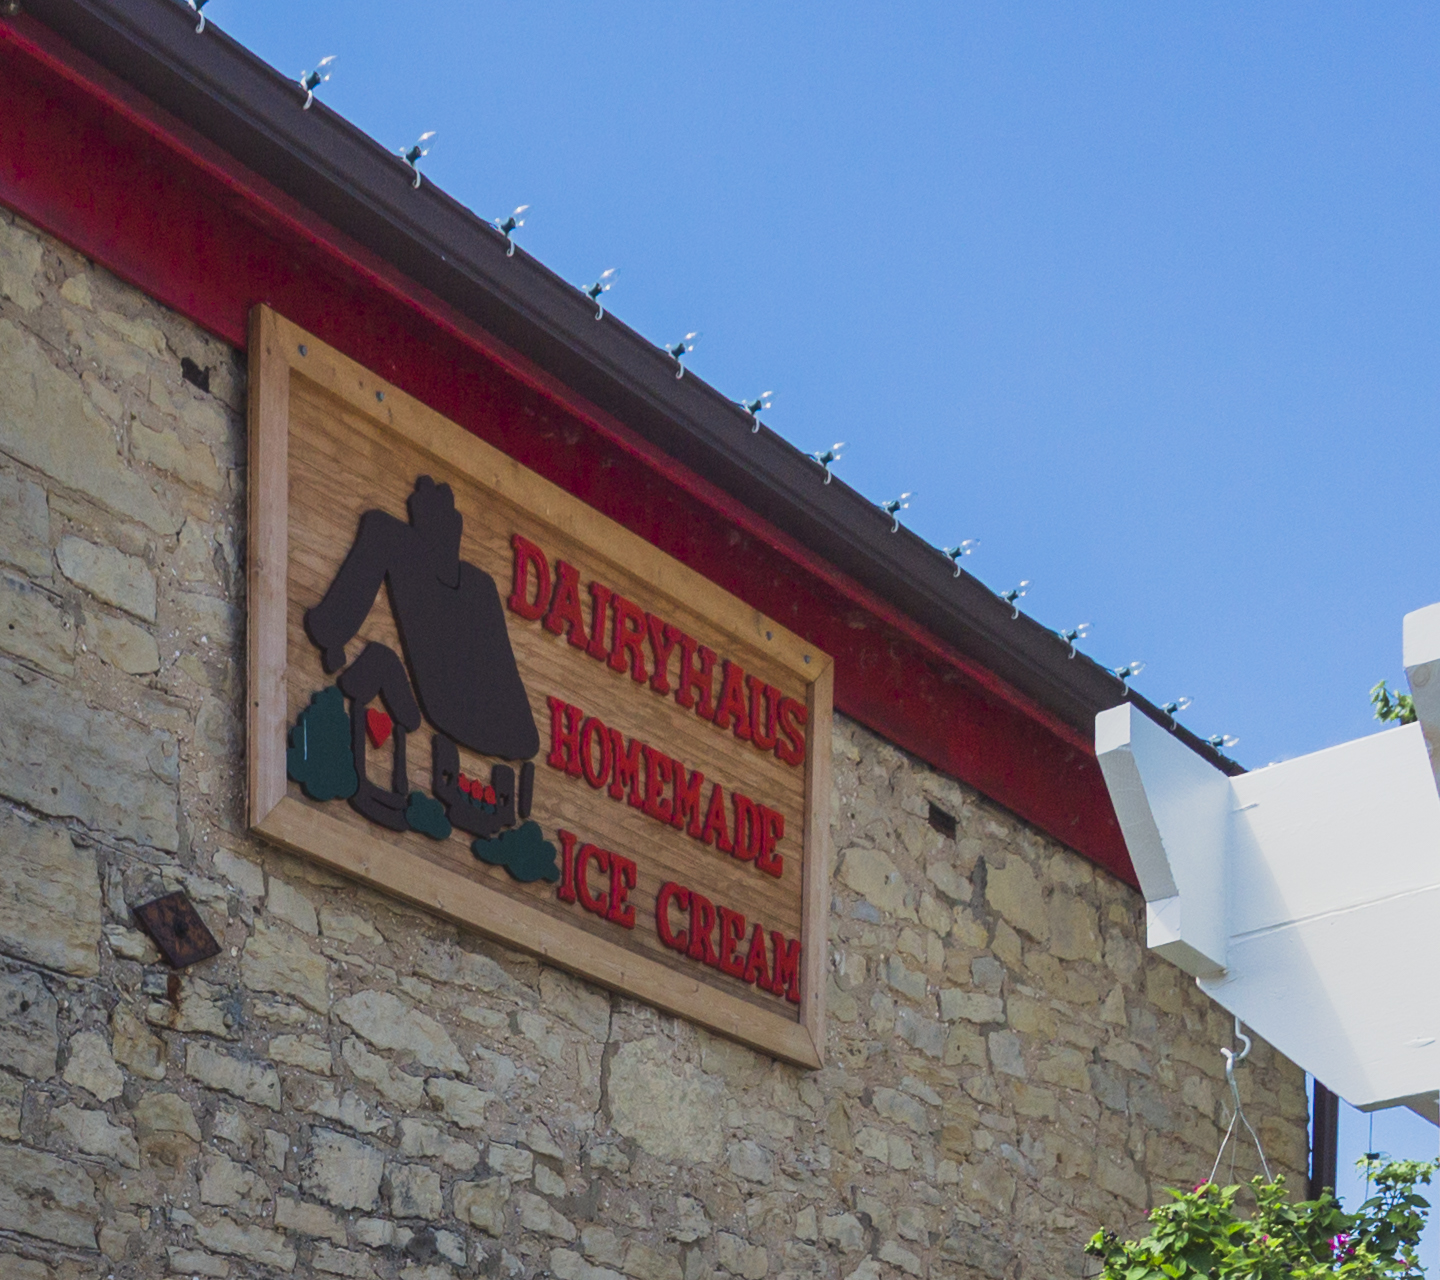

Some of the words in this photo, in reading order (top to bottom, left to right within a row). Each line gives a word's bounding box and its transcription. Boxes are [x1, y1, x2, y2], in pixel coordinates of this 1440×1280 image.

[507, 533, 809, 767] DAIRYHAUS
[546, 696, 785, 878] HOMEMADE
[556, 829, 637, 930] ICE
[655, 880, 802, 1004] CREAM
